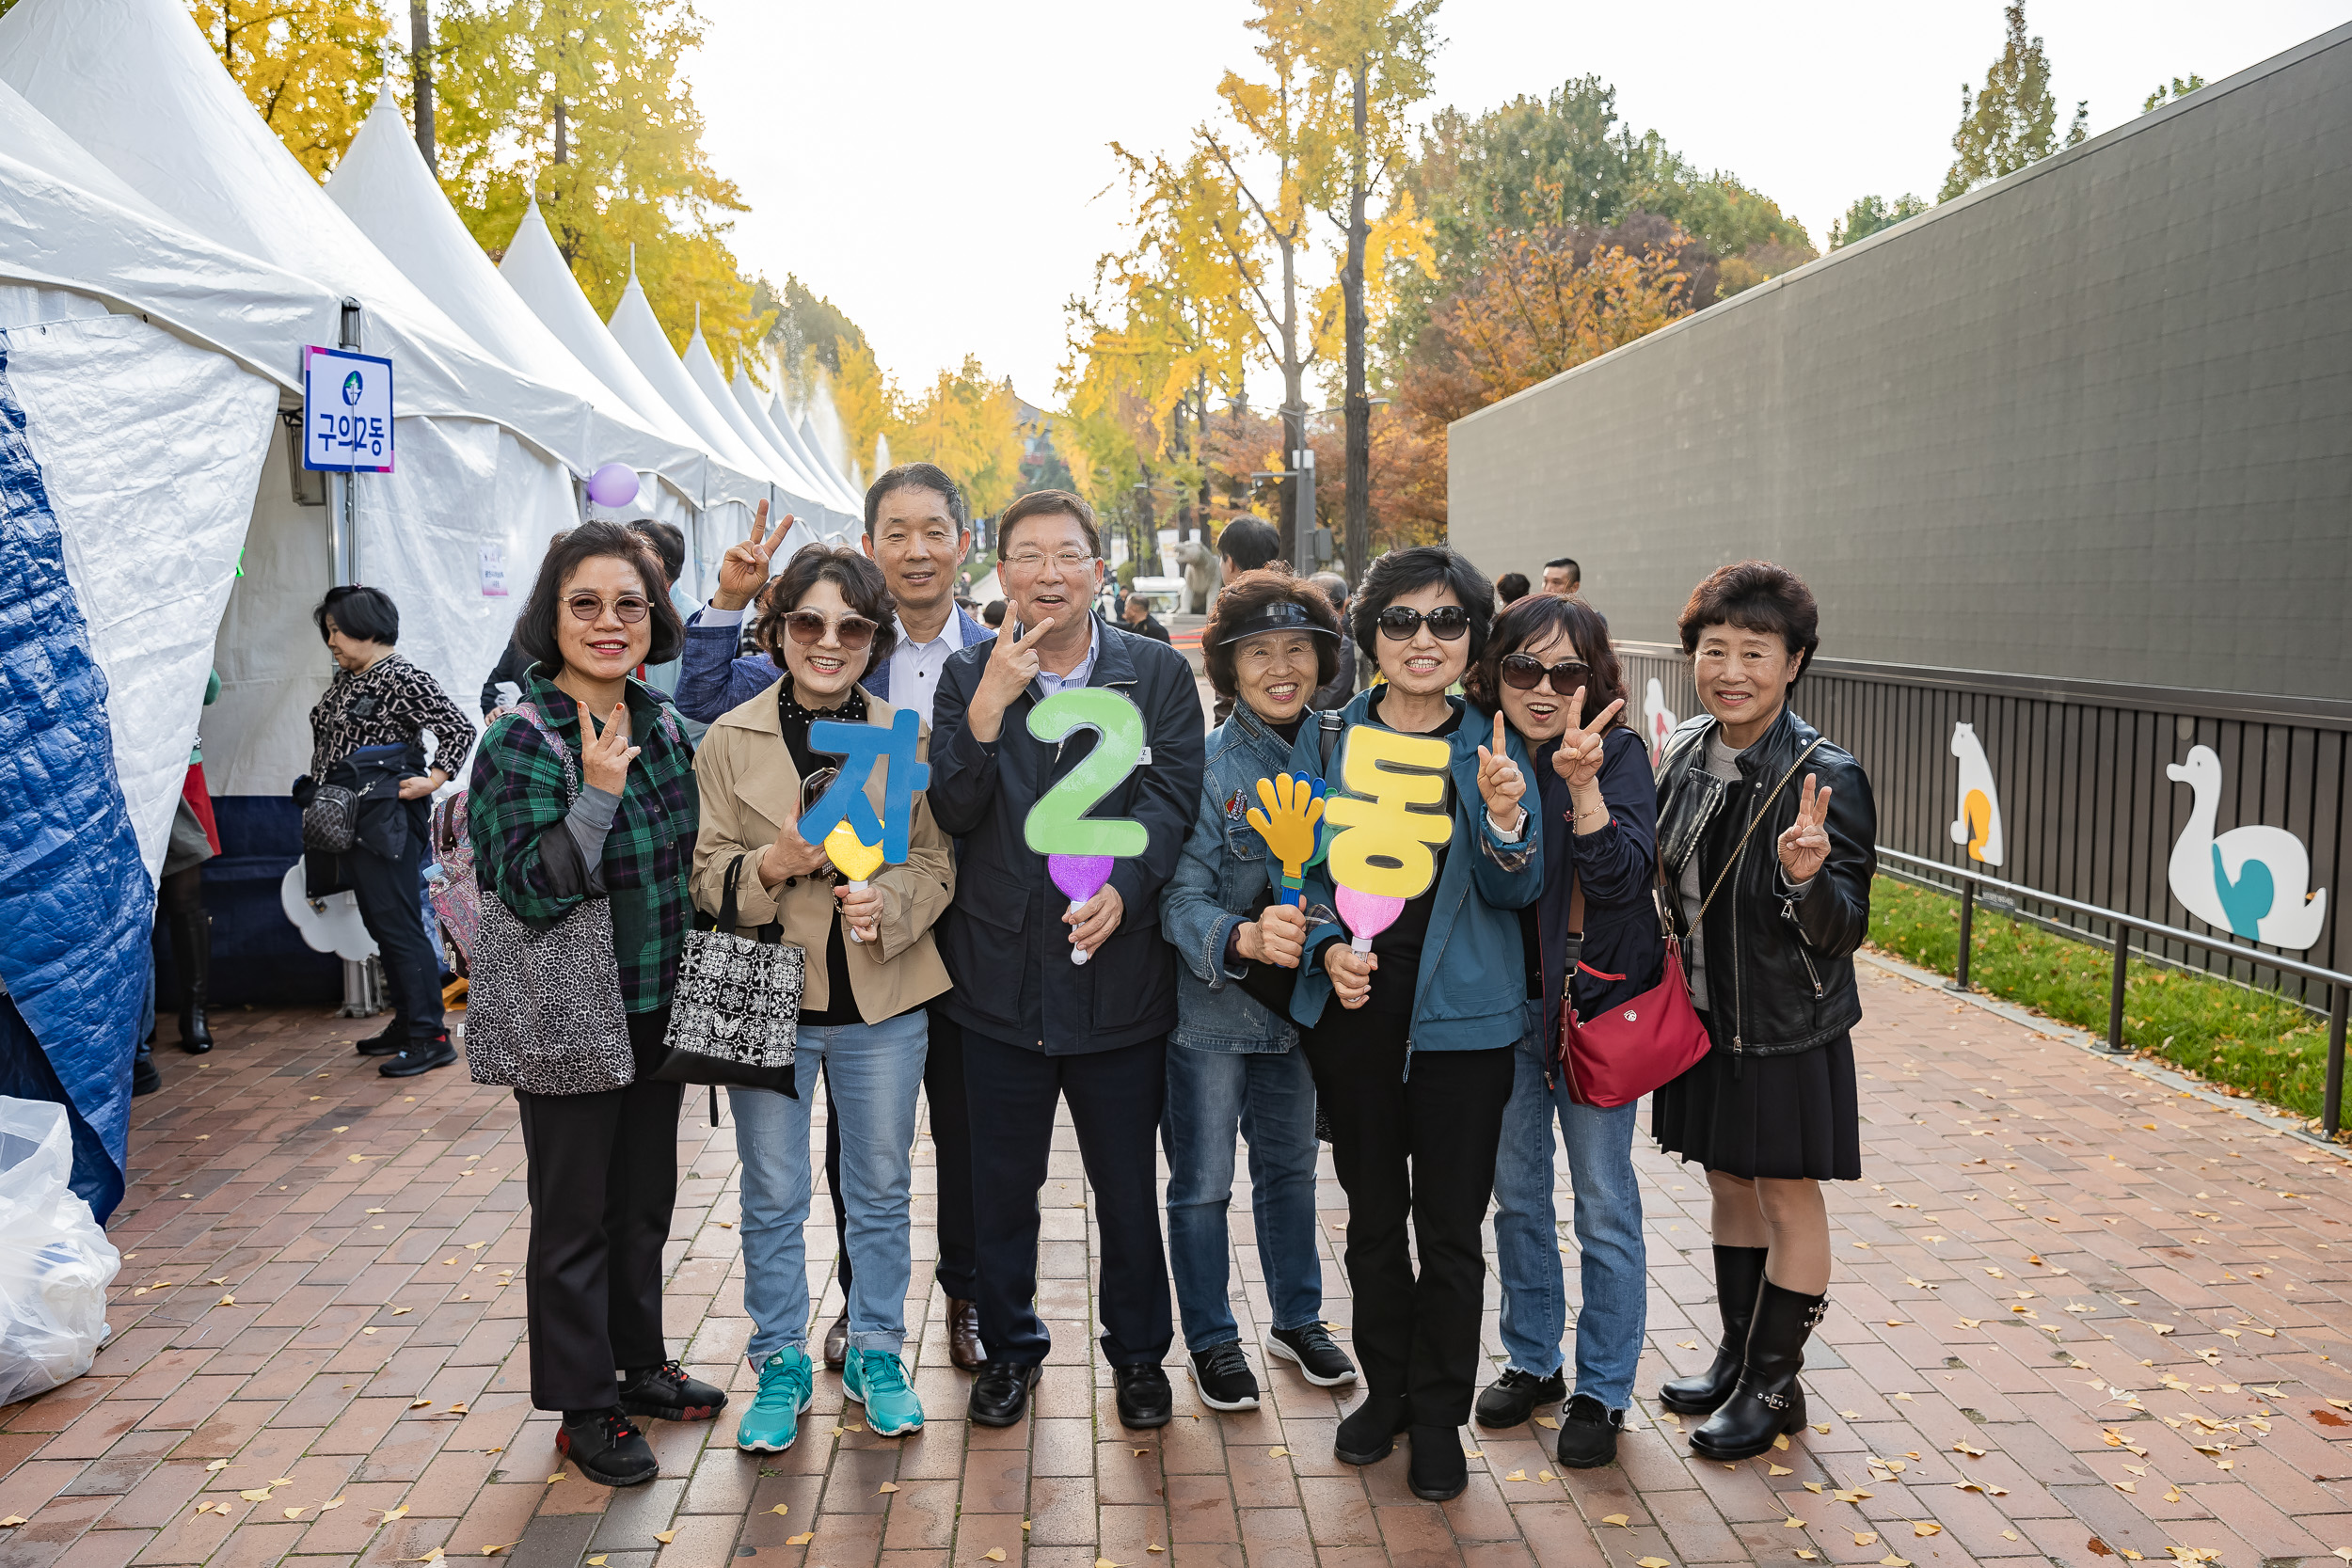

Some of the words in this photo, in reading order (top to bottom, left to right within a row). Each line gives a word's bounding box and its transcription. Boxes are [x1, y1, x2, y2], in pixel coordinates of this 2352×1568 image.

[318, 414, 385, 456] 구의2동
[797, 709, 930, 864] 자
[1025, 688, 1148, 857] 2
[1325, 725, 1453, 898] 동
